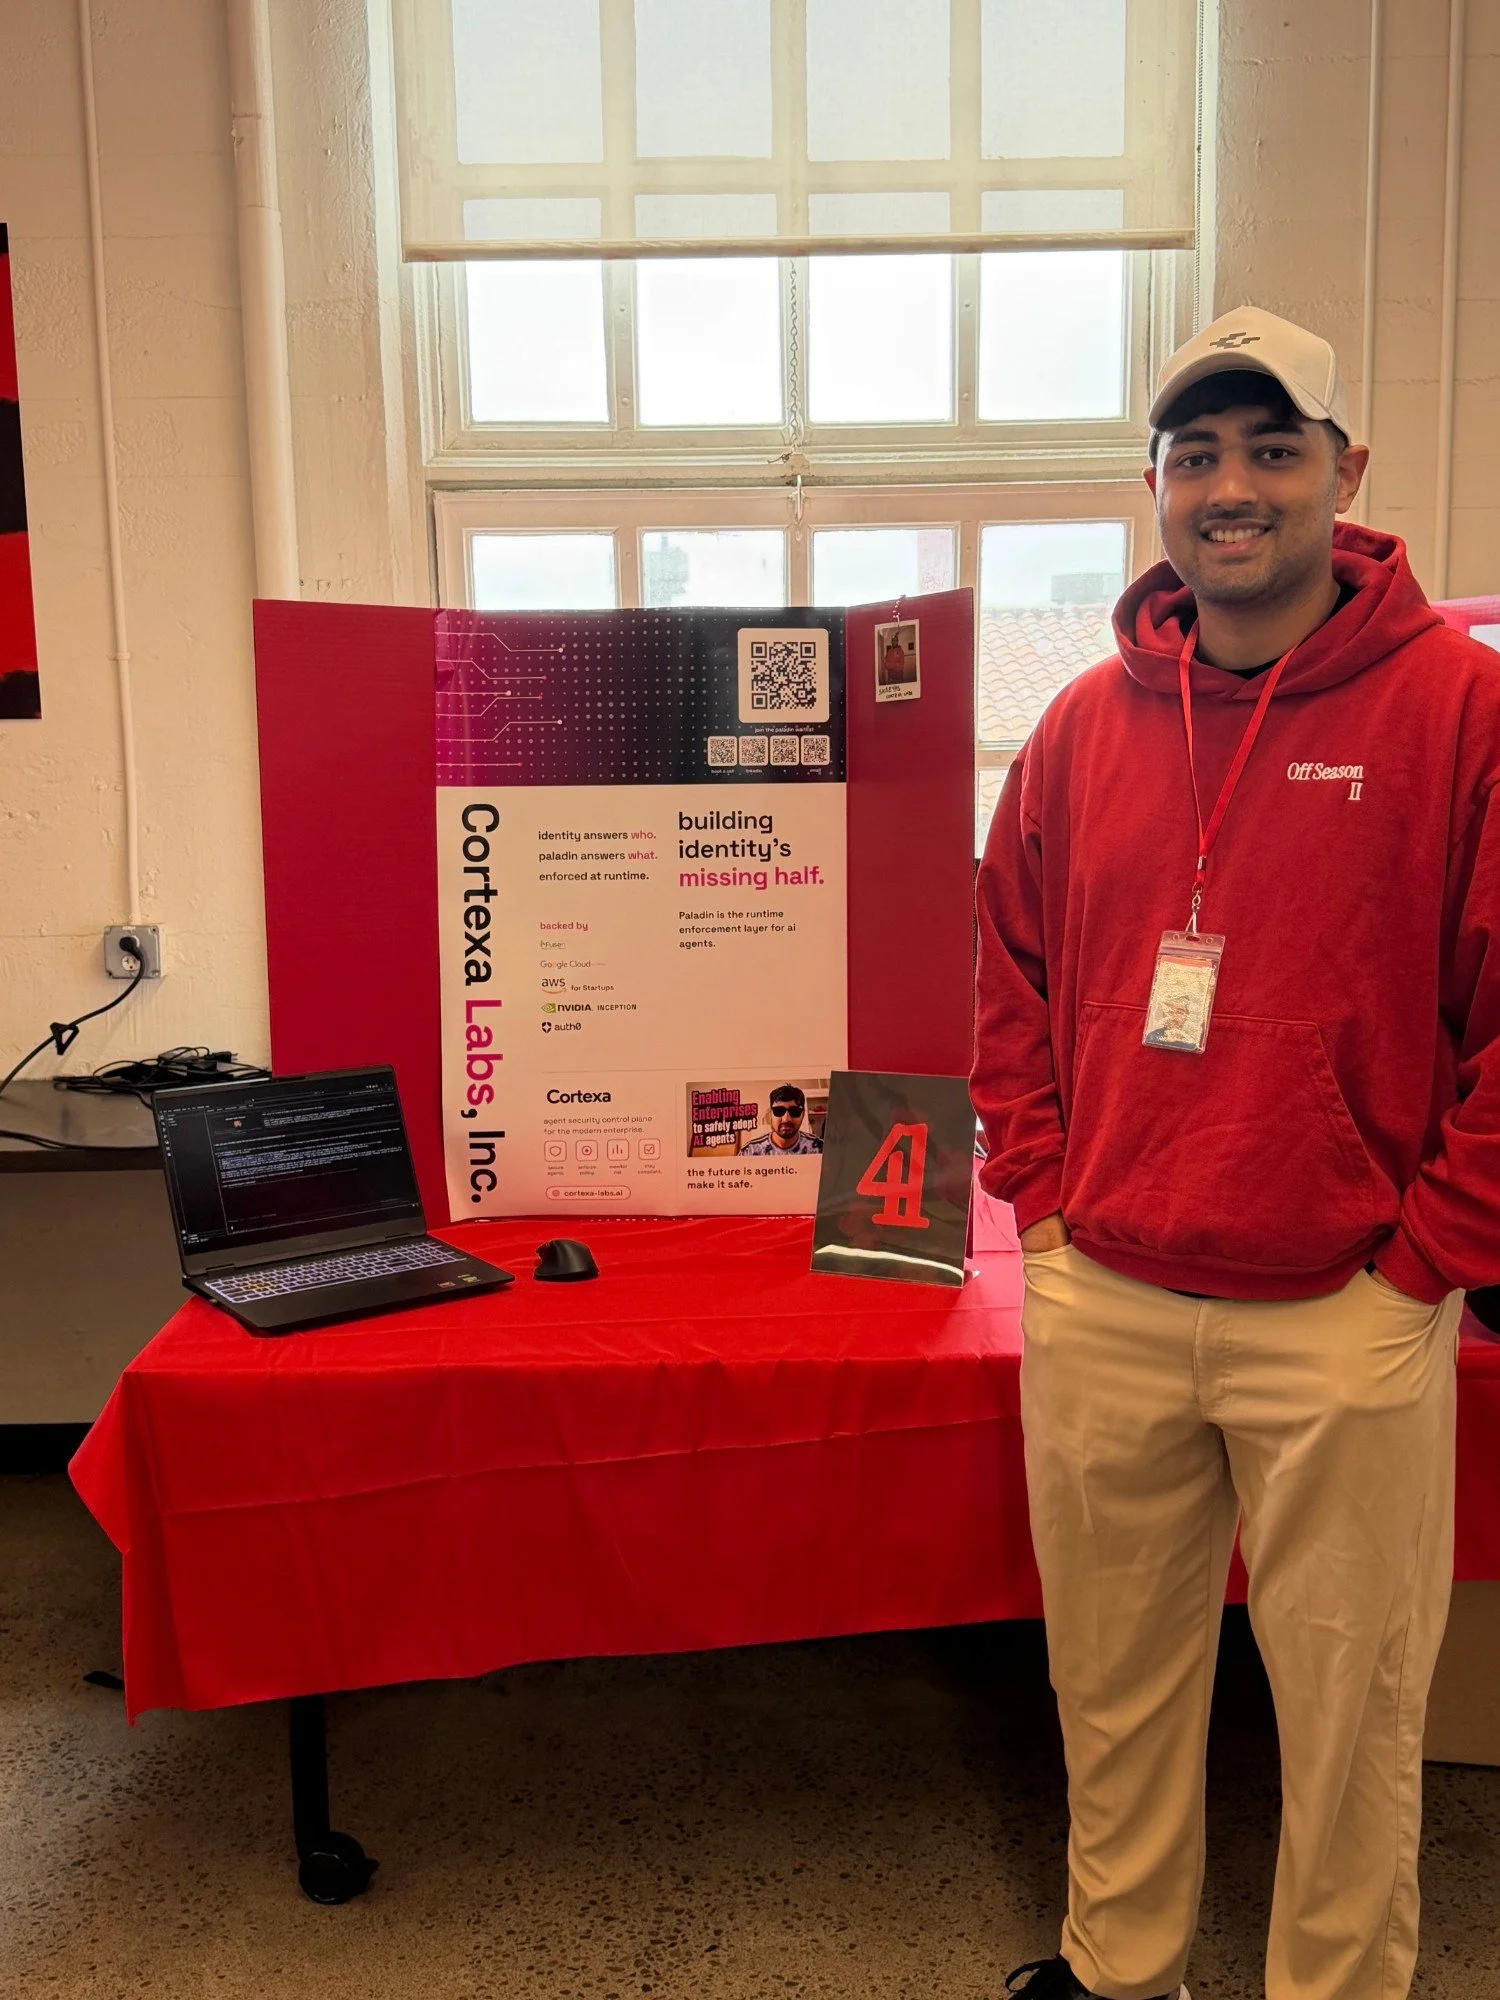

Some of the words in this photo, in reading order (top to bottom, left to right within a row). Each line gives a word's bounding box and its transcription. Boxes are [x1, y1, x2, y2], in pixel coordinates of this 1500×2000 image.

[1286, 762, 1314, 780] Off
[1312, 762, 1364, 780] Season
[1347, 782, 1364, 800] II
[678, 810, 773, 834] building
[538, 830, 581, 842] identity
[583, 832, 628, 840] answers
[630, 830, 657, 839] who.
[539, 851, 578, 862] paladin
[628, 851, 658, 860] what.
[678, 838, 792, 862] identity’s
[539, 872, 588, 880] enforced
[590, 872, 601, 880] at
[604, 871, 649, 880] runtime.
[680, 867, 768, 890] missing
[775, 866, 824, 885] half.
[462, 804, 500, 986] Cortexa
[679, 910, 714, 919] Paladin
[717, 911, 725, 919] is
[727, 910, 744, 919] the
[746, 910, 784, 918] runtime
[540, 922, 574, 930] backed
[576, 922, 589, 931] by
[679, 925, 742, 934] enforcement
[744, 924, 768, 934] layer
[771, 924, 784, 932] for
[788, 924, 796, 932] ai
[679, 940, 716, 949] agents.
[540, 960, 568, 969] Google
[542, 978, 566, 987] aws
[554, 1023, 582, 1031] auth0
[460, 1000, 504, 1118] Labs,
[546, 1089, 611, 1104] Cortexa
[692, 1088, 739, 1106] Enabling
[692, 1104, 758, 1120] Enterprises
[693, 1122, 702, 1133] to
[704, 1121, 731, 1133] safely
[732, 1118, 757, 1131] adopt
[693, 1136, 704, 1146] AI
[706, 1133, 735, 1146] agents
[468, 1130, 506, 1203] Inc.
[687, 1168, 704, 1177] the
[708, 1168, 741, 1176] future
[743, 1167, 752, 1175] is
[755, 1166, 798, 1177] agentic.
[687, 1181, 714, 1189] make
[718, 1180, 725, 1188] it
[728, 1180, 753, 1188] safe.
